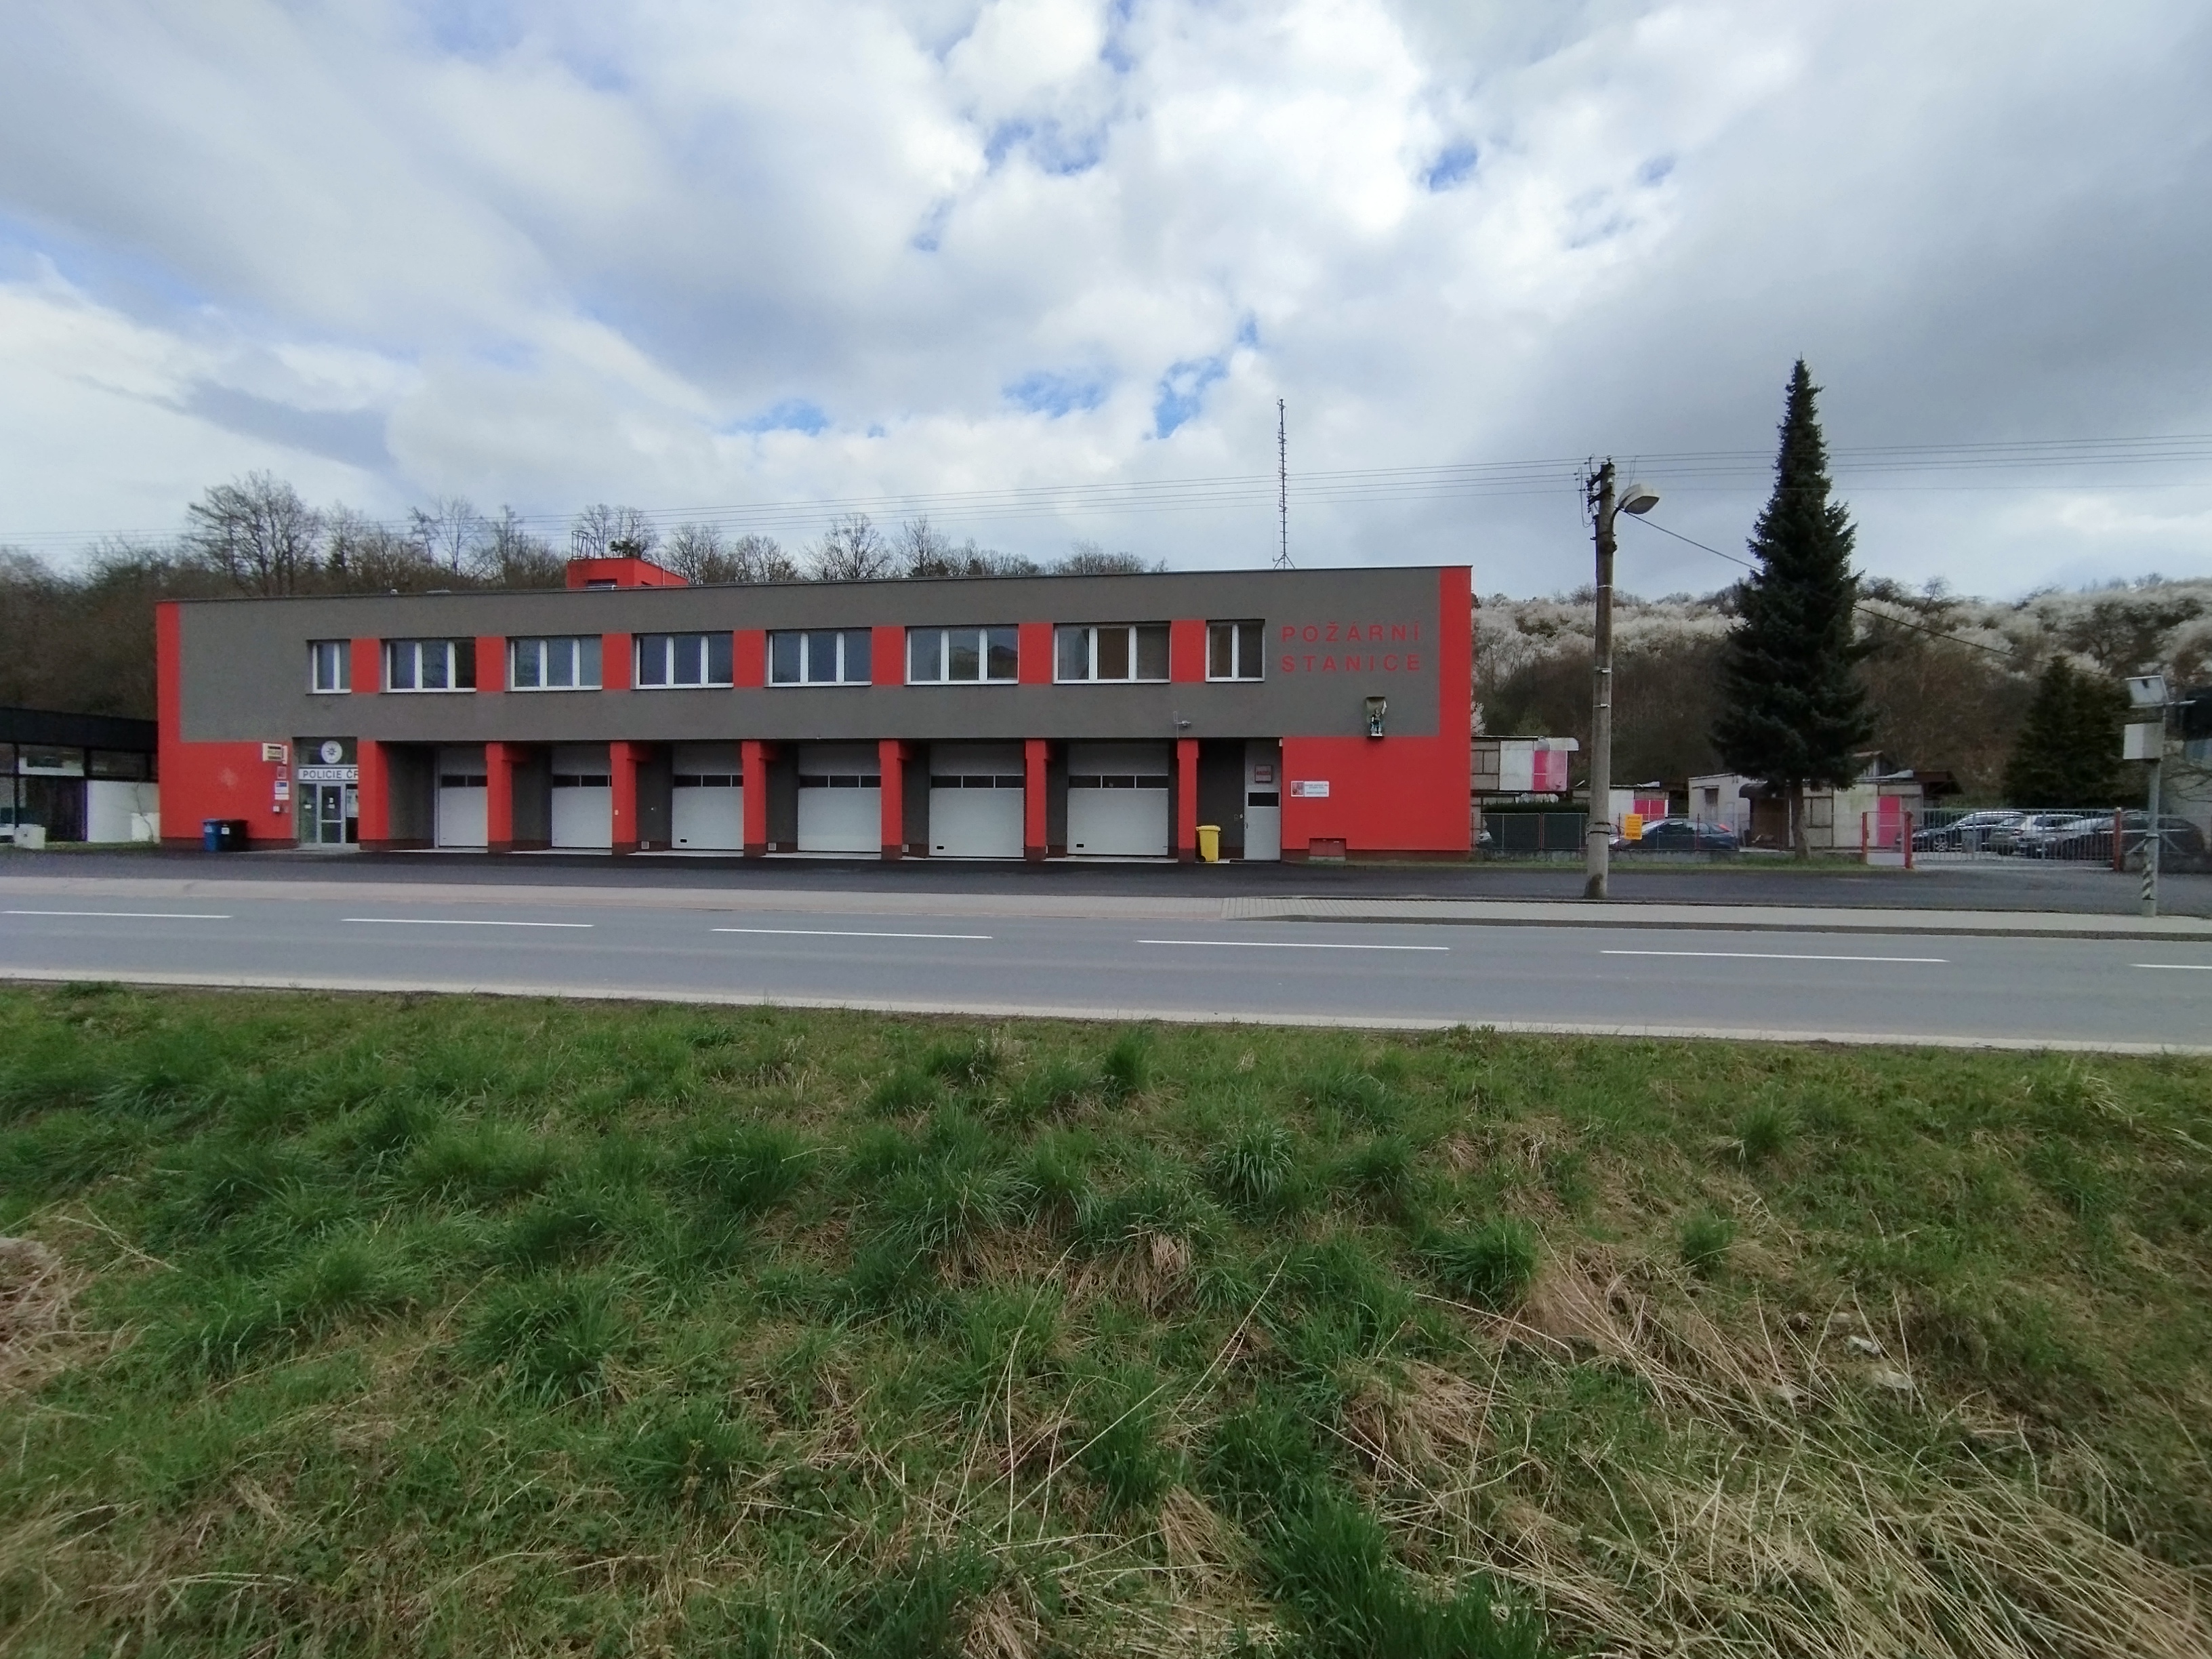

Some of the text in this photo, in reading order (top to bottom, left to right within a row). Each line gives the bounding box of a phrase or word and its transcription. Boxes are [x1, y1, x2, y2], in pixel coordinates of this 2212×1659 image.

[1282, 621, 1420, 643] POŽÁRNÍ
[1281, 654, 1421, 673] STANICE
[303, 770, 342, 779] POLICIE
